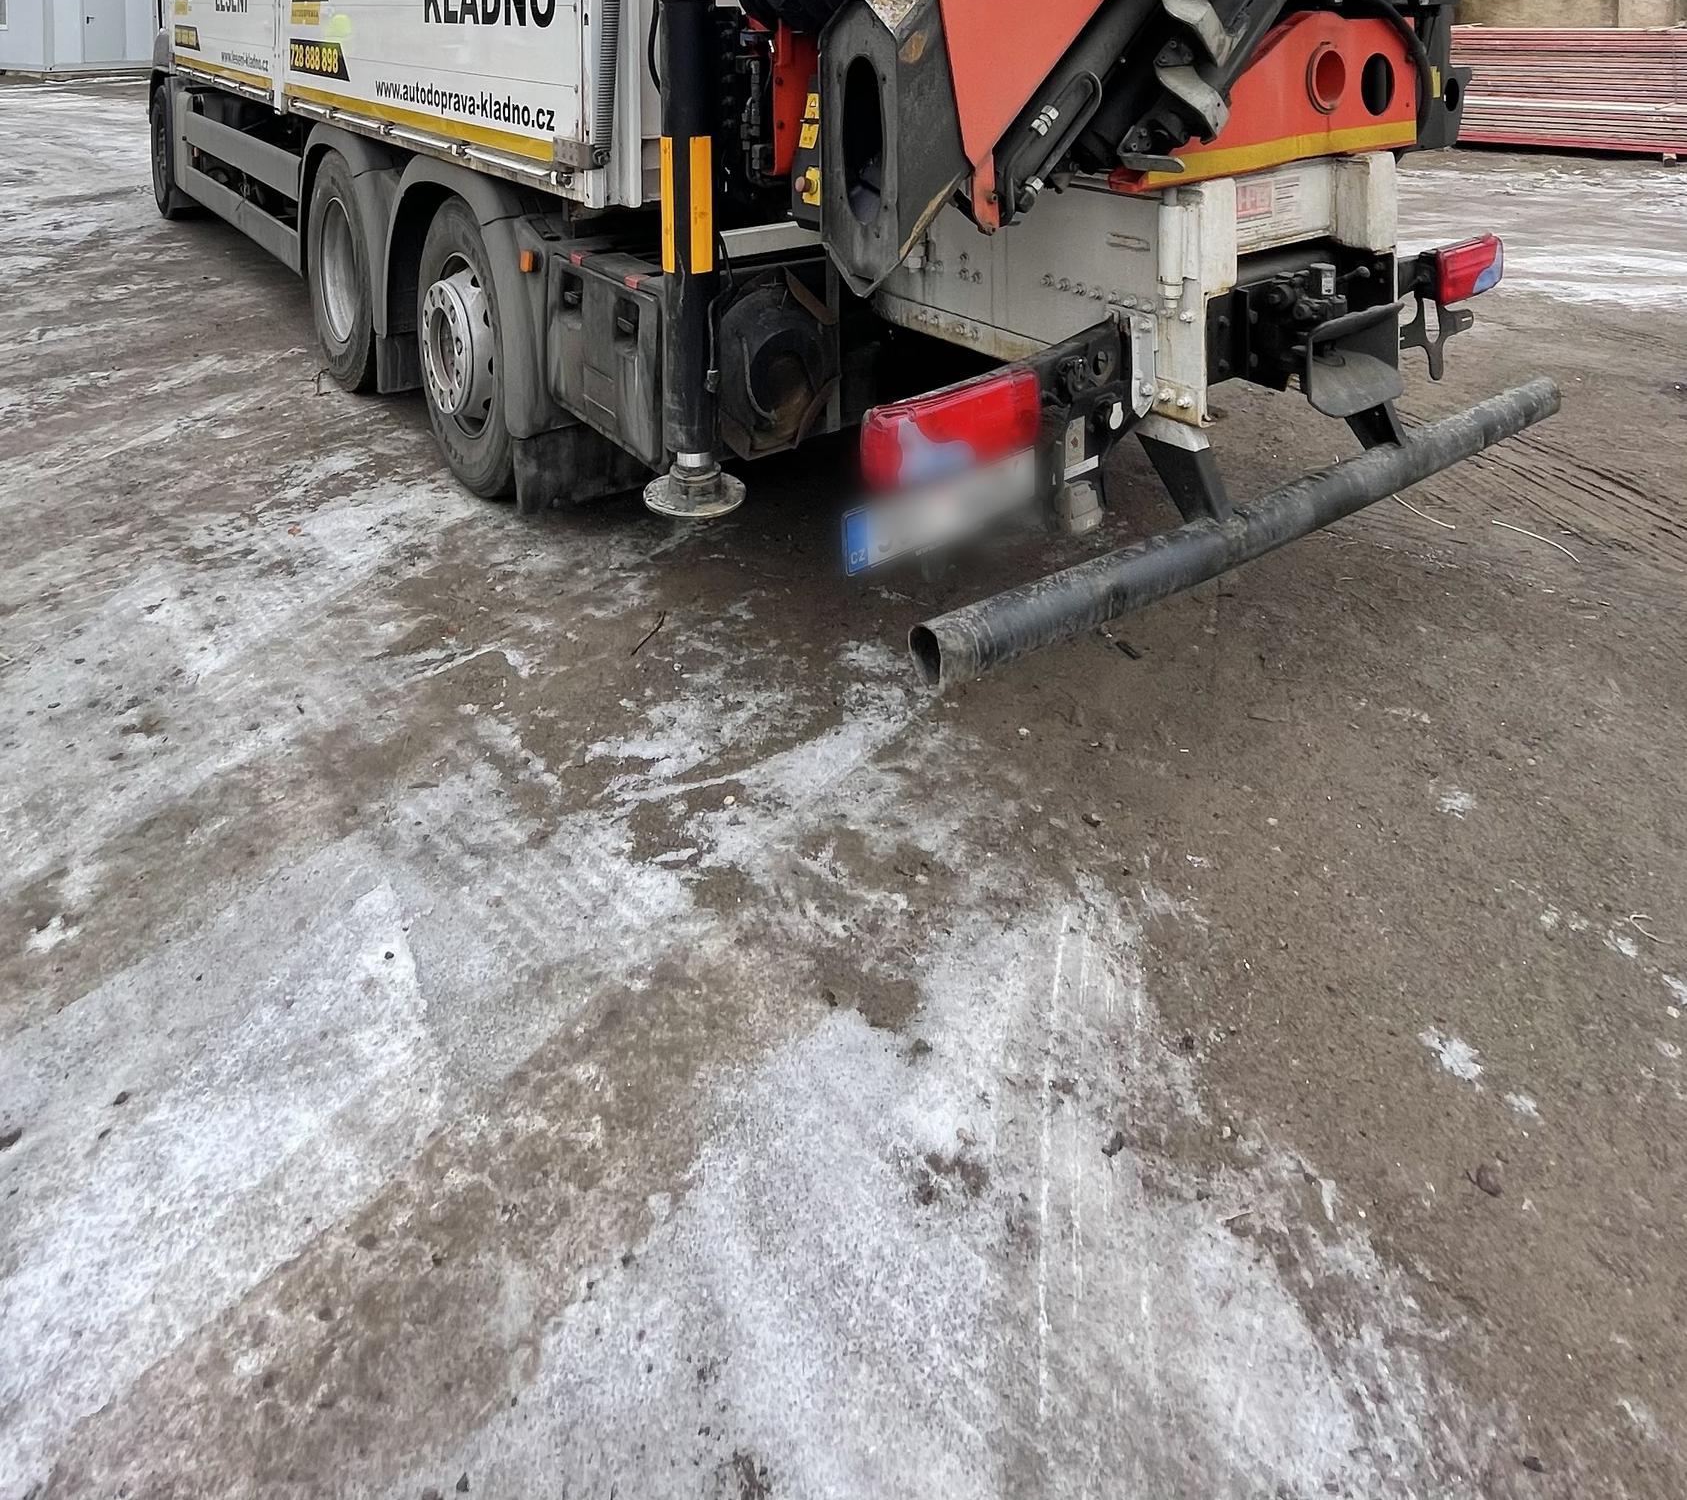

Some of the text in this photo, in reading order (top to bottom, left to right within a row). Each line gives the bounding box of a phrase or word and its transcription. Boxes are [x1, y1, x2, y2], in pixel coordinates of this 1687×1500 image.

[290, 43, 339, 74] 728 888 898
[375, 79, 556, 132] www.autodoprava-kladno.cz
[850, 547, 867, 565] CZ
